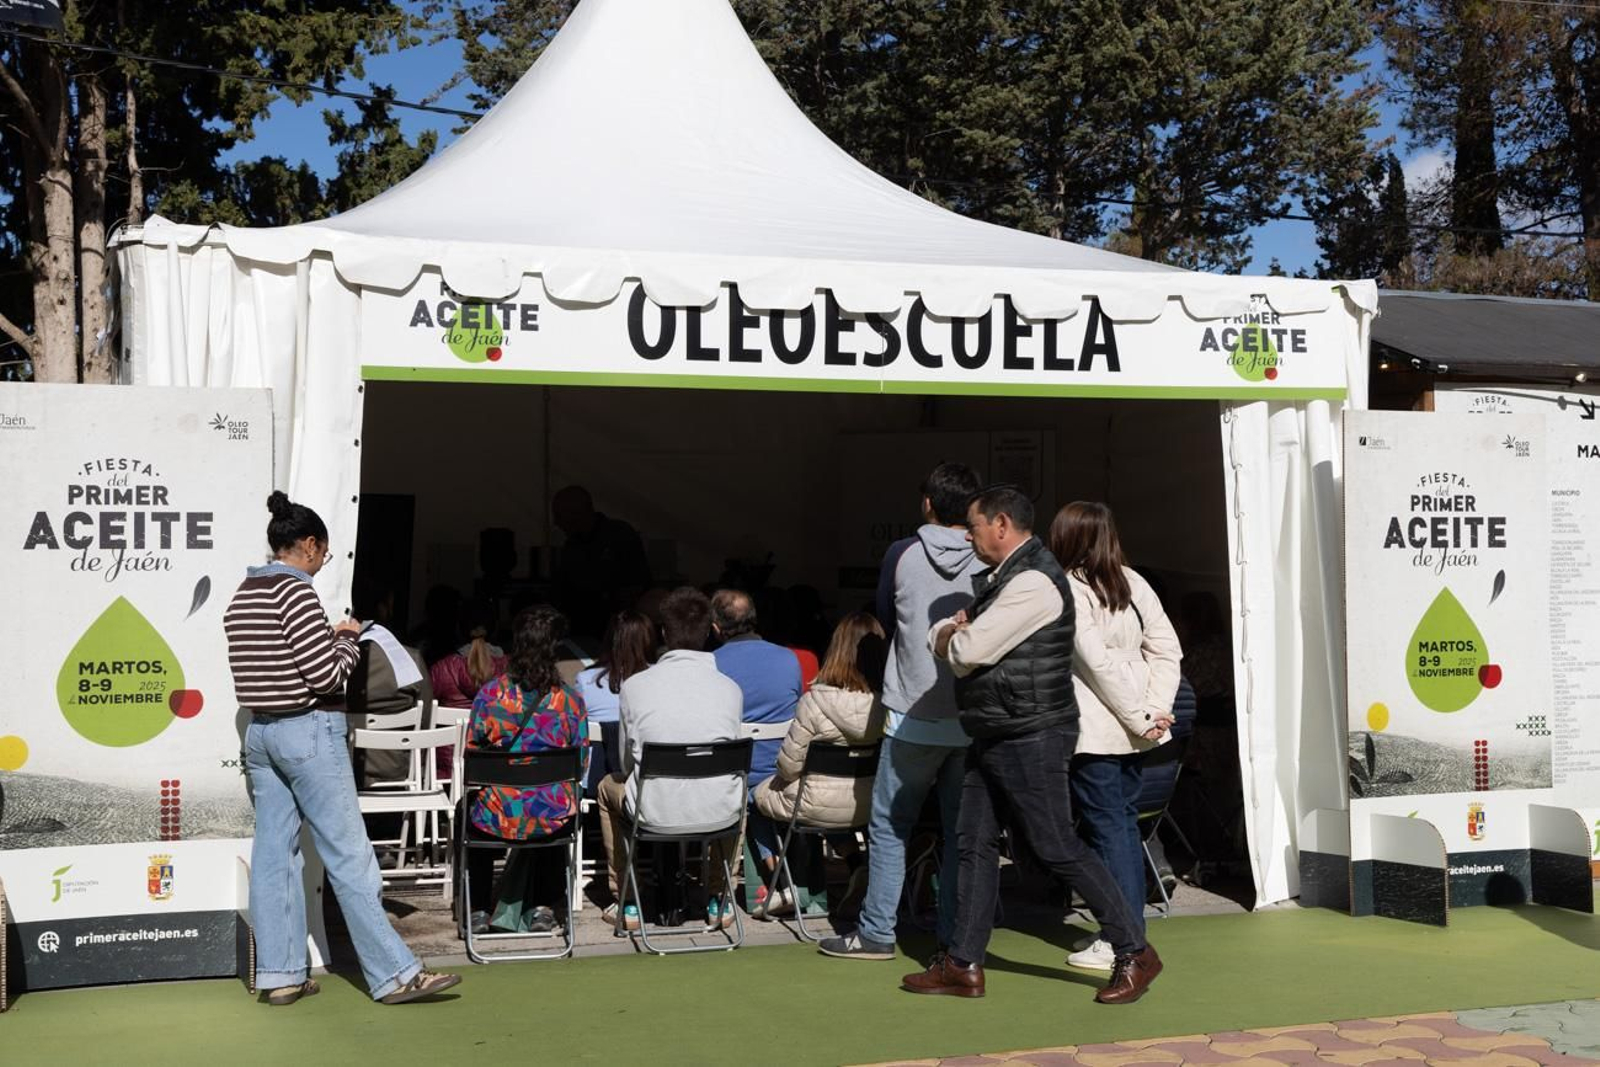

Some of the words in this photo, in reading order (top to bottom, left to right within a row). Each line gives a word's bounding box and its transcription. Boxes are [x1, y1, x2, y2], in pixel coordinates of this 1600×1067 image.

[409, 300, 539, 331] ACEITE
[441, 316, 464, 345] de
[465, 327, 511, 352] Jaén
[627, 281, 1121, 372] OLEOESCUELA
[1200, 327, 1307, 353] ACEITE
[1226, 344, 1245, 366] de
[1246, 352, 1284, 373] Jaén
[107, 474, 128, 487] del
[1435, 485, 1451, 497] del
[68, 485, 169, 506] PRIMER
[1410, 495, 1476, 512] PRIMER
[23, 511, 214, 550] ACEITE
[1383, 517, 1507, 549] ACEITE
[70, 549, 102, 572] de
[104, 549, 172, 583] Jaén
[1412, 547, 1432, 567] de
[1434, 548, 1478, 576] Jaén
[1419, 655, 1441, 667] 8-9
[1418, 667, 1475, 678] NOVIEMBRE
[78, 678, 112, 692] 8-9
[139, 681, 167, 692] 2025
[78, 693, 163, 705] NOVIEMBRE
[75, 928, 199, 946] primeraceitejaen.es
